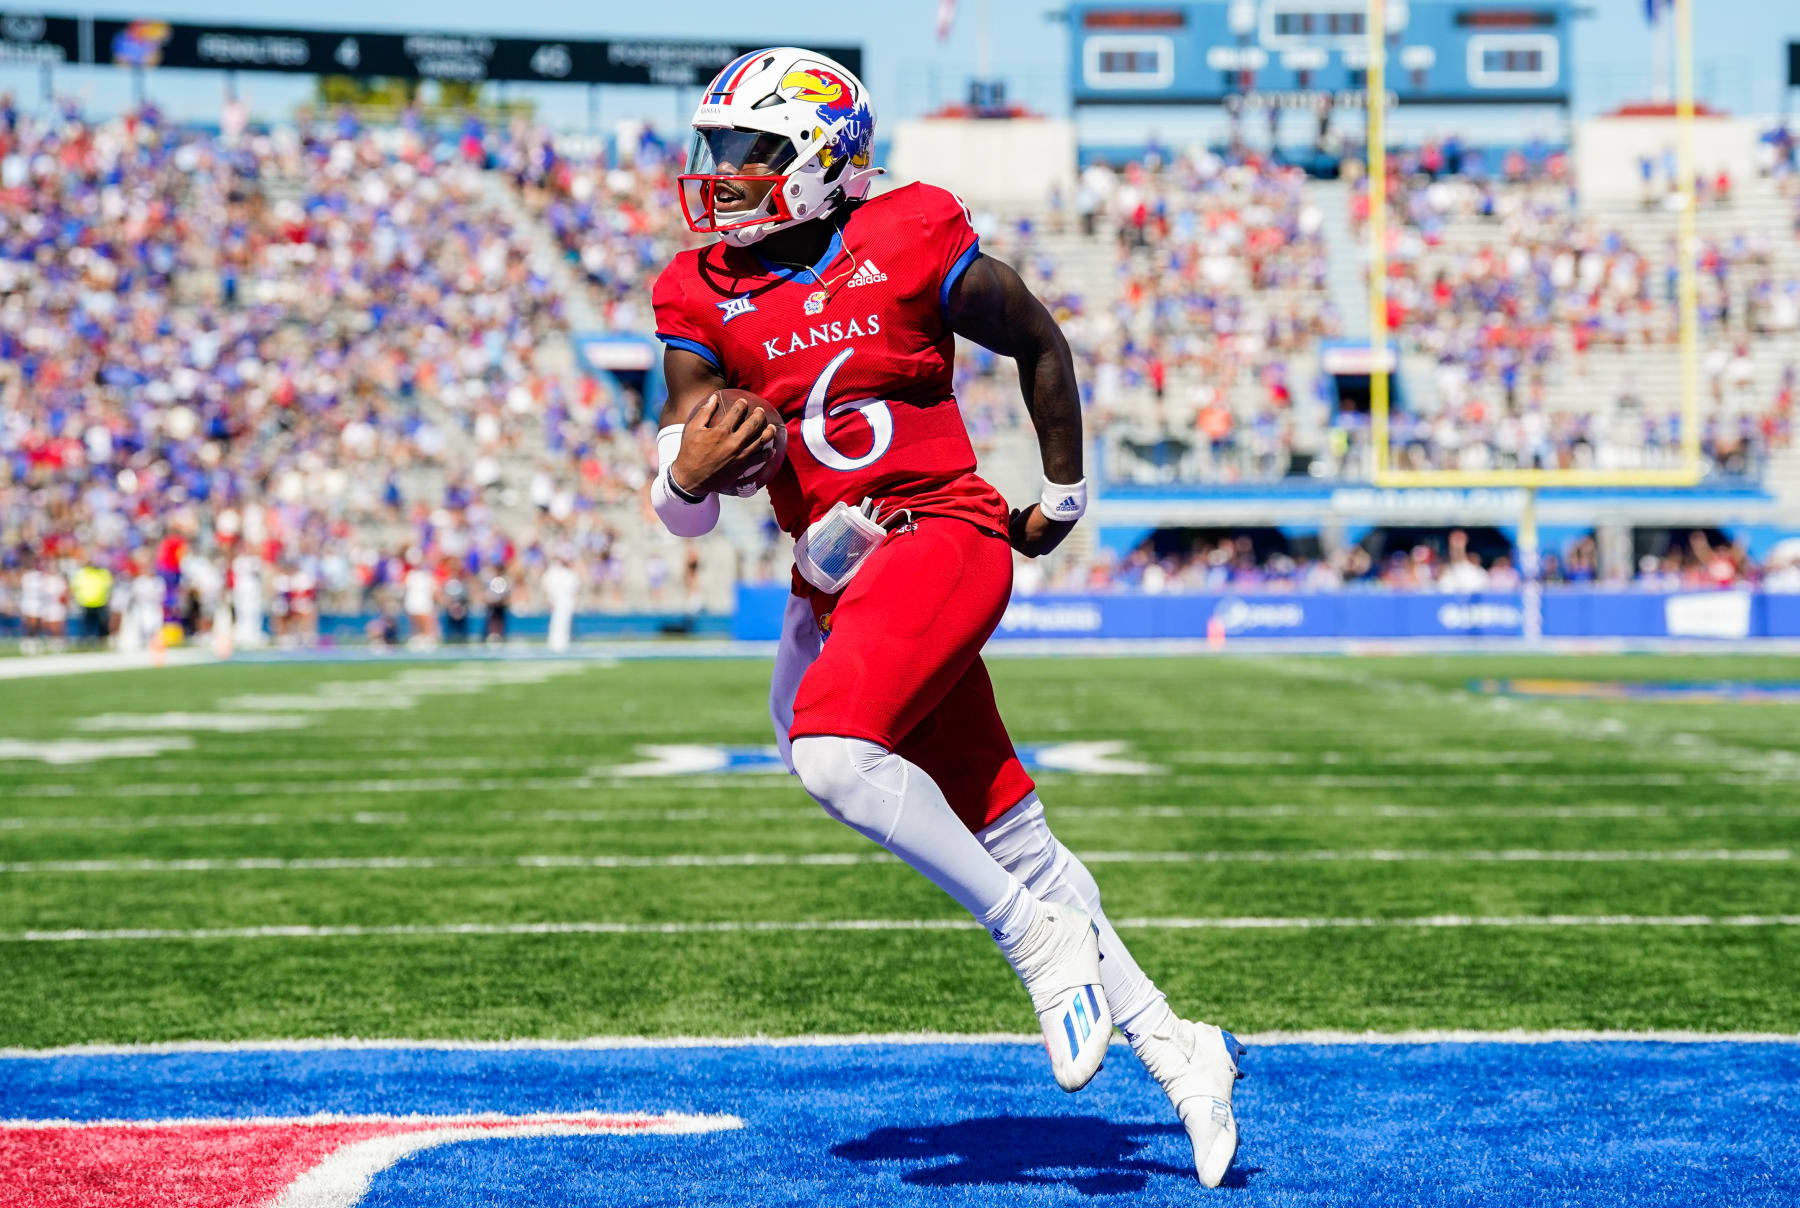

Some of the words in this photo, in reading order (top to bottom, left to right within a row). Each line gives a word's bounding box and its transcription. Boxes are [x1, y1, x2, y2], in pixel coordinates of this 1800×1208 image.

[847, 271, 887, 288] adidas
[762, 314, 880, 360] KANSAS
[801, 347, 894, 472] 6
